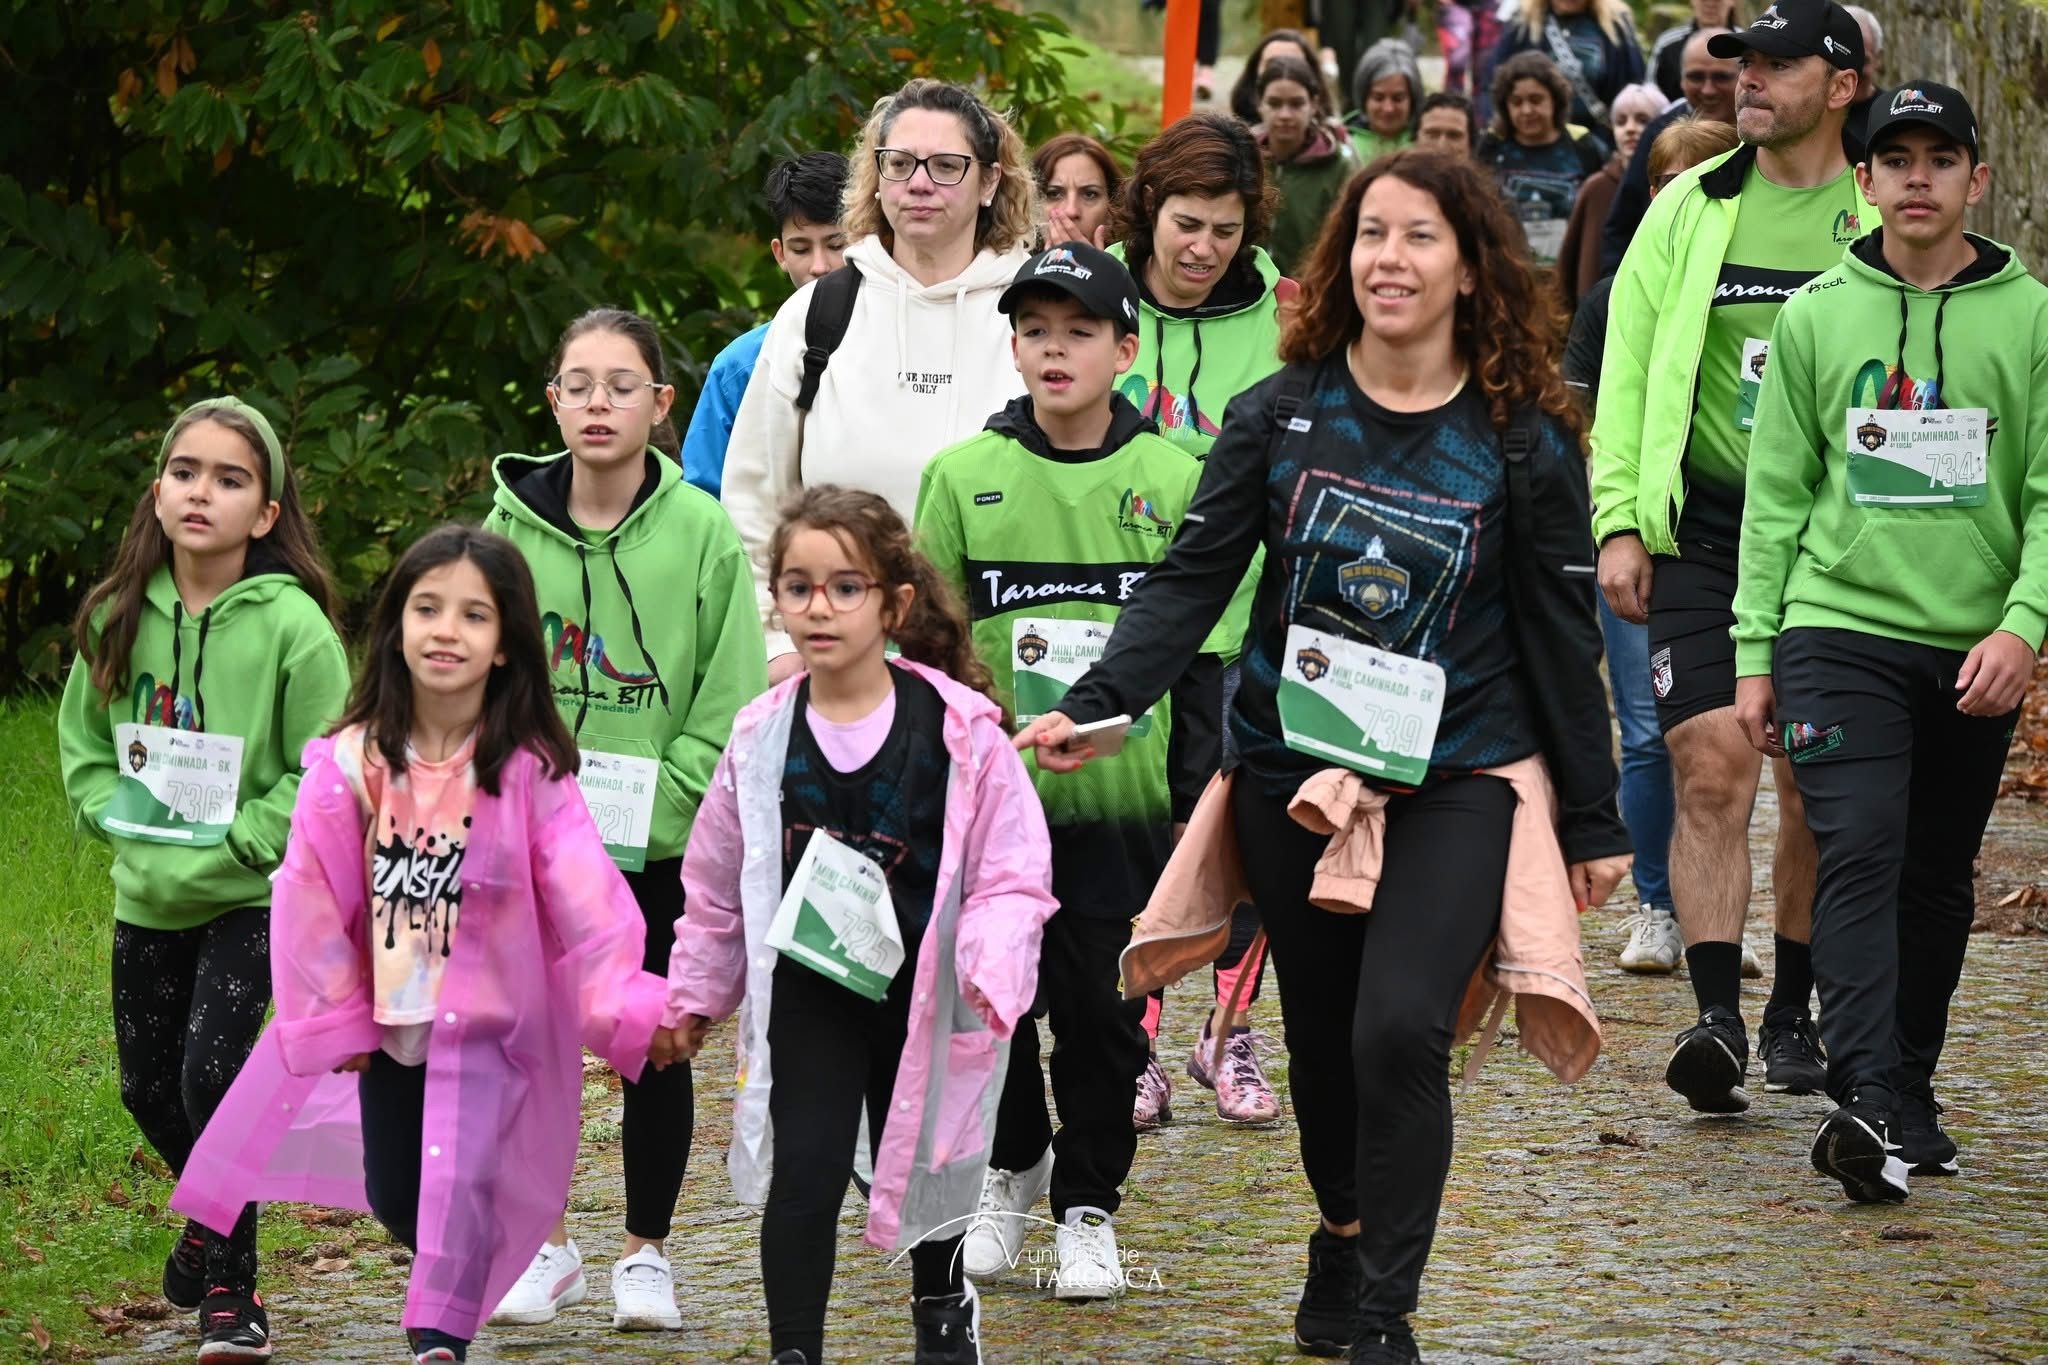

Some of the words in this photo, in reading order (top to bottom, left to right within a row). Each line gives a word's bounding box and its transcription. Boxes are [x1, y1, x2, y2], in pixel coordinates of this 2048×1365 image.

[912, 383, 938, 395] ONLY
[921, 373, 953, 384] NIGHT
[1890, 431, 1909, 442] MINI
[1912, 430, 1959, 442] CAMINHADA
[1967, 429, 1978, 440] 6K
[1926, 452, 1975, 488] 734
[982, 570, 1106, 608] Tarouca
[1052, 643, 1072, 656] MINI
[1075, 644, 1104, 658] CAMIN
[1332, 664, 1353, 683] MINI
[1354, 671, 1409, 697] CAMINHADA
[595, 703, 642, 715] pedalar
[617, 683, 659, 709] BTT
[1360, 703, 1423, 758] 739
[162, 752, 208, 771] CMINHADA
[218, 759, 231, 773] 6K
[579, 774, 624, 792] AMINHADA
[167, 780, 225, 826] 736
[588, 801, 634, 847] 721
[829, 910, 888, 972] 725
